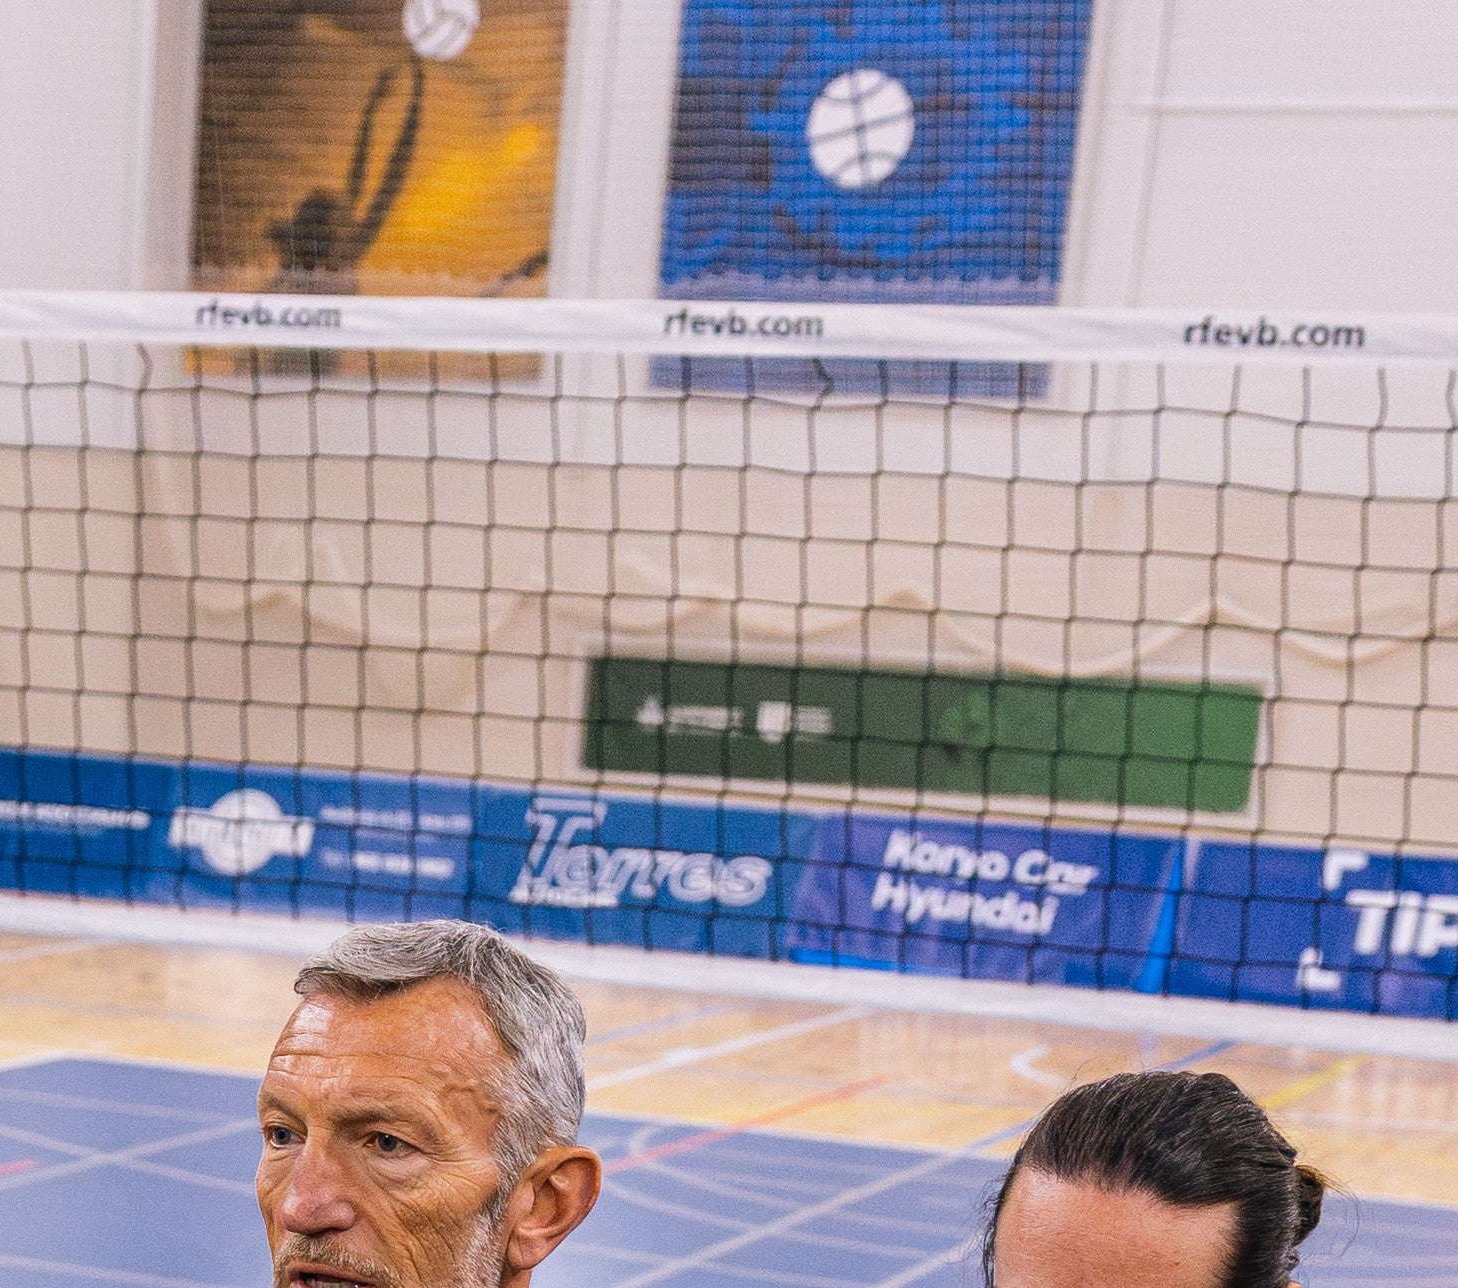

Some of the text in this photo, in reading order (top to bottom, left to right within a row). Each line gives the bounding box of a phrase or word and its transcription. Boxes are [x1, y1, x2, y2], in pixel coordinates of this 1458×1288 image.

[194, 301, 343, 329] rfevb.com
[662, 309, 824, 338] rfevb.com
[1183, 316, 1365, 348] rfevb.com
[872, 872, 1058, 935] Hyundai
